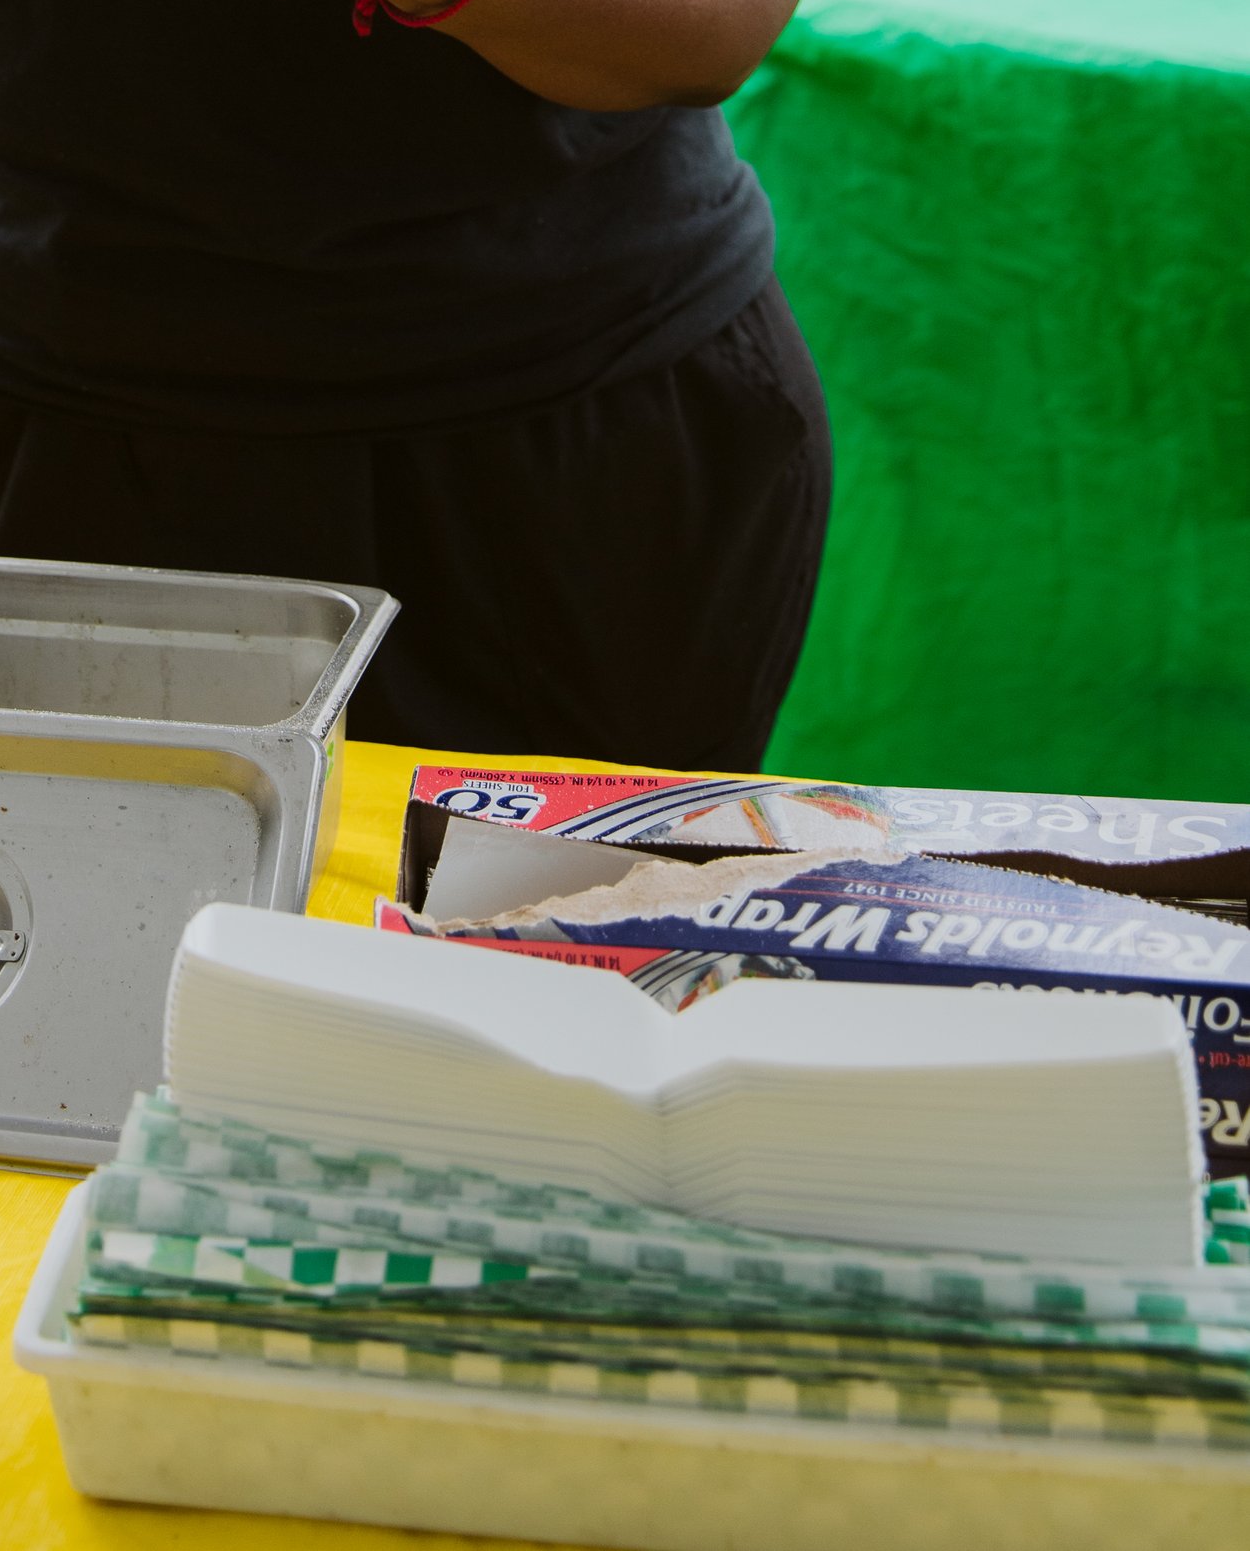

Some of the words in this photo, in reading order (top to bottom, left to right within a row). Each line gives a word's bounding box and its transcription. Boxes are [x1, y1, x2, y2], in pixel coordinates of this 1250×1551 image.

[463, 780, 503, 791] SHEETS
[511, 782, 530, 793] FOIL
[569, 777, 584, 786] IN.
[586, 777, 601, 786] 1/4
[605, 778, 617, 786] 10
[631, 777, 645, 786] IN.
[647, 778, 659, 787] 14
[436, 788, 539, 821] 50
[892, 797, 1229, 857] Sheets
[843, 882, 887, 896] 1947
[895, 888, 959, 904] SINCE
[964, 897, 1059, 914] TRUSTED
[698, 890, 892, 952] Wrap
[895, 909, 1246, 976] Reynolds
